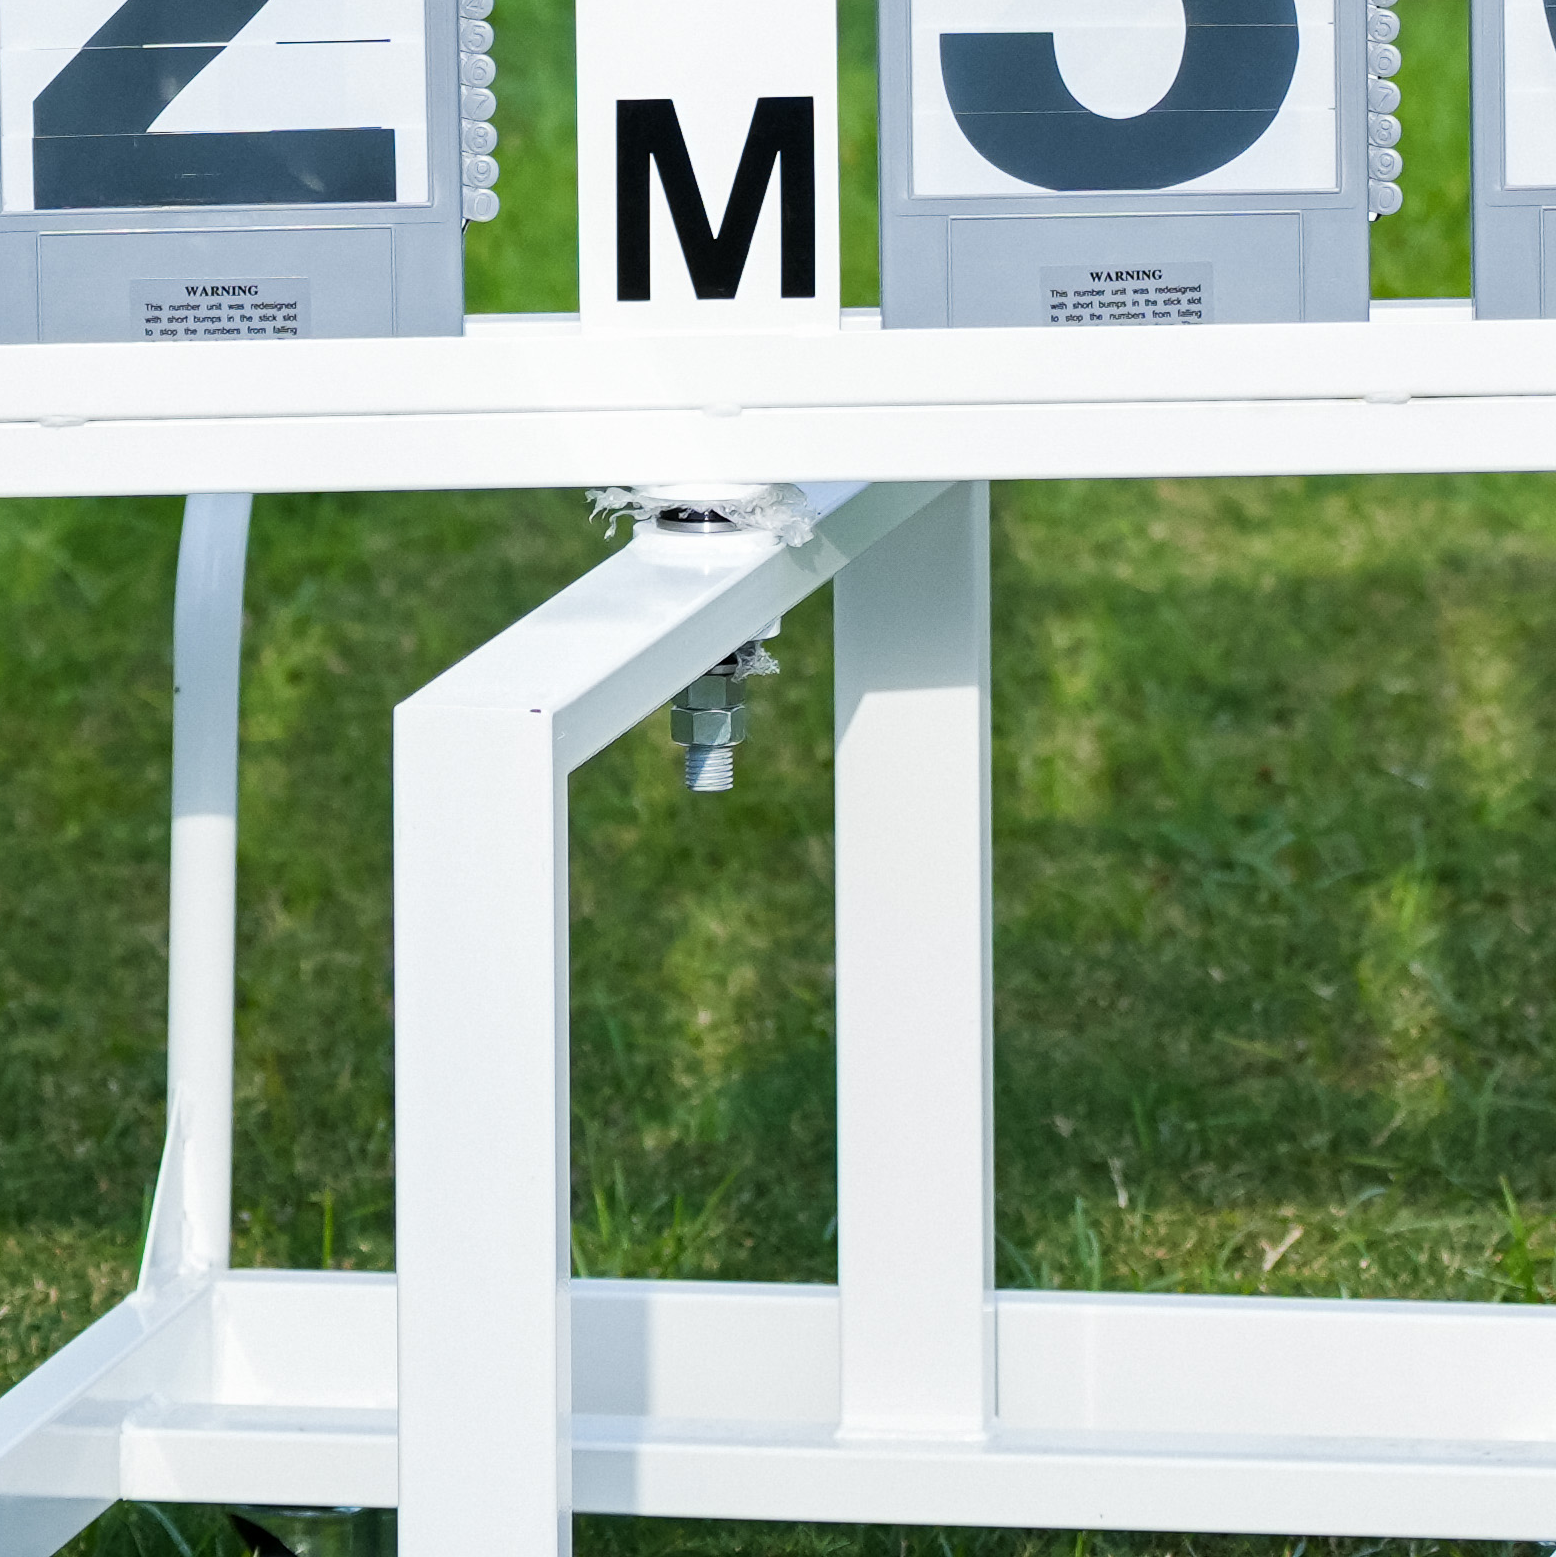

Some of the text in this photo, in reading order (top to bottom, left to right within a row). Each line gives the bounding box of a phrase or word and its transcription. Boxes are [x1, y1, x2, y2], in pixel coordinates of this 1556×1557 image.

[616, 96, 816, 302] M
[1090, 269, 1162, 282] WARNING
[185, 284, 258, 297] WARNING
[1050, 289, 1068, 298] This
[1074, 288, 1105, 297] number
[1111, 288, 1126, 296] unit
[1155, 284, 1201, 296] redesigned
[1050, 301, 1067, 310] with
[1073, 300, 1093, 310] short
[1098, 299, 1127, 310] bumps
[1132, 299, 1139, 307] in
[1163, 297, 1182, 307] stick
[1187, 296, 1202, 305] slot
[1051, 315, 1059, 323] to
[1065, 314, 1083, 323] stop
[1089, 312, 1103, 321] the
[1109, 310, 1146, 321] numbers
[1152, 309, 1171, 318] from
[1178, 308, 1202, 320] falling
